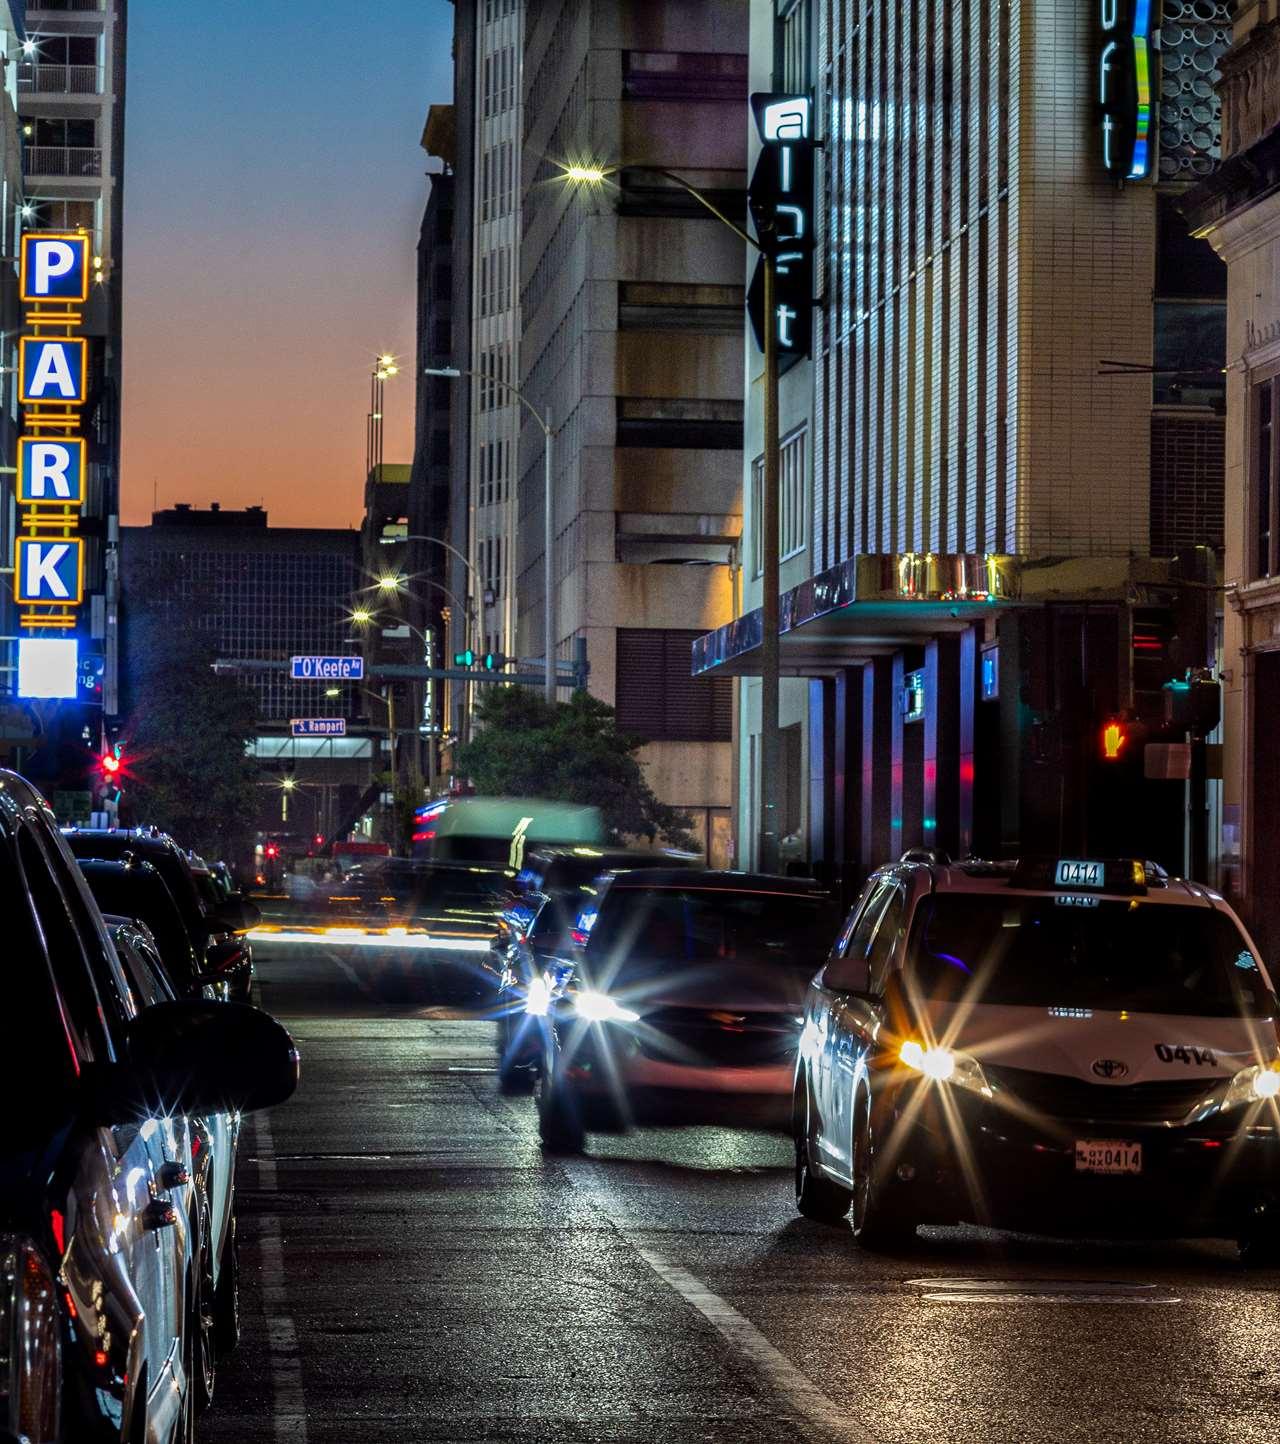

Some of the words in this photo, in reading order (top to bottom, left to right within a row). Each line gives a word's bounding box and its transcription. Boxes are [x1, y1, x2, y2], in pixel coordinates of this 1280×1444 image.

[27, 240, 76, 598] PARK
[302, 658, 350, 677] O'Keefe
[309, 720, 343, 733] Rampart
[1060, 862, 1098, 884] 0414
[1154, 1043, 1218, 1068] 0414
[1105, 1150, 1139, 1167] 0414
